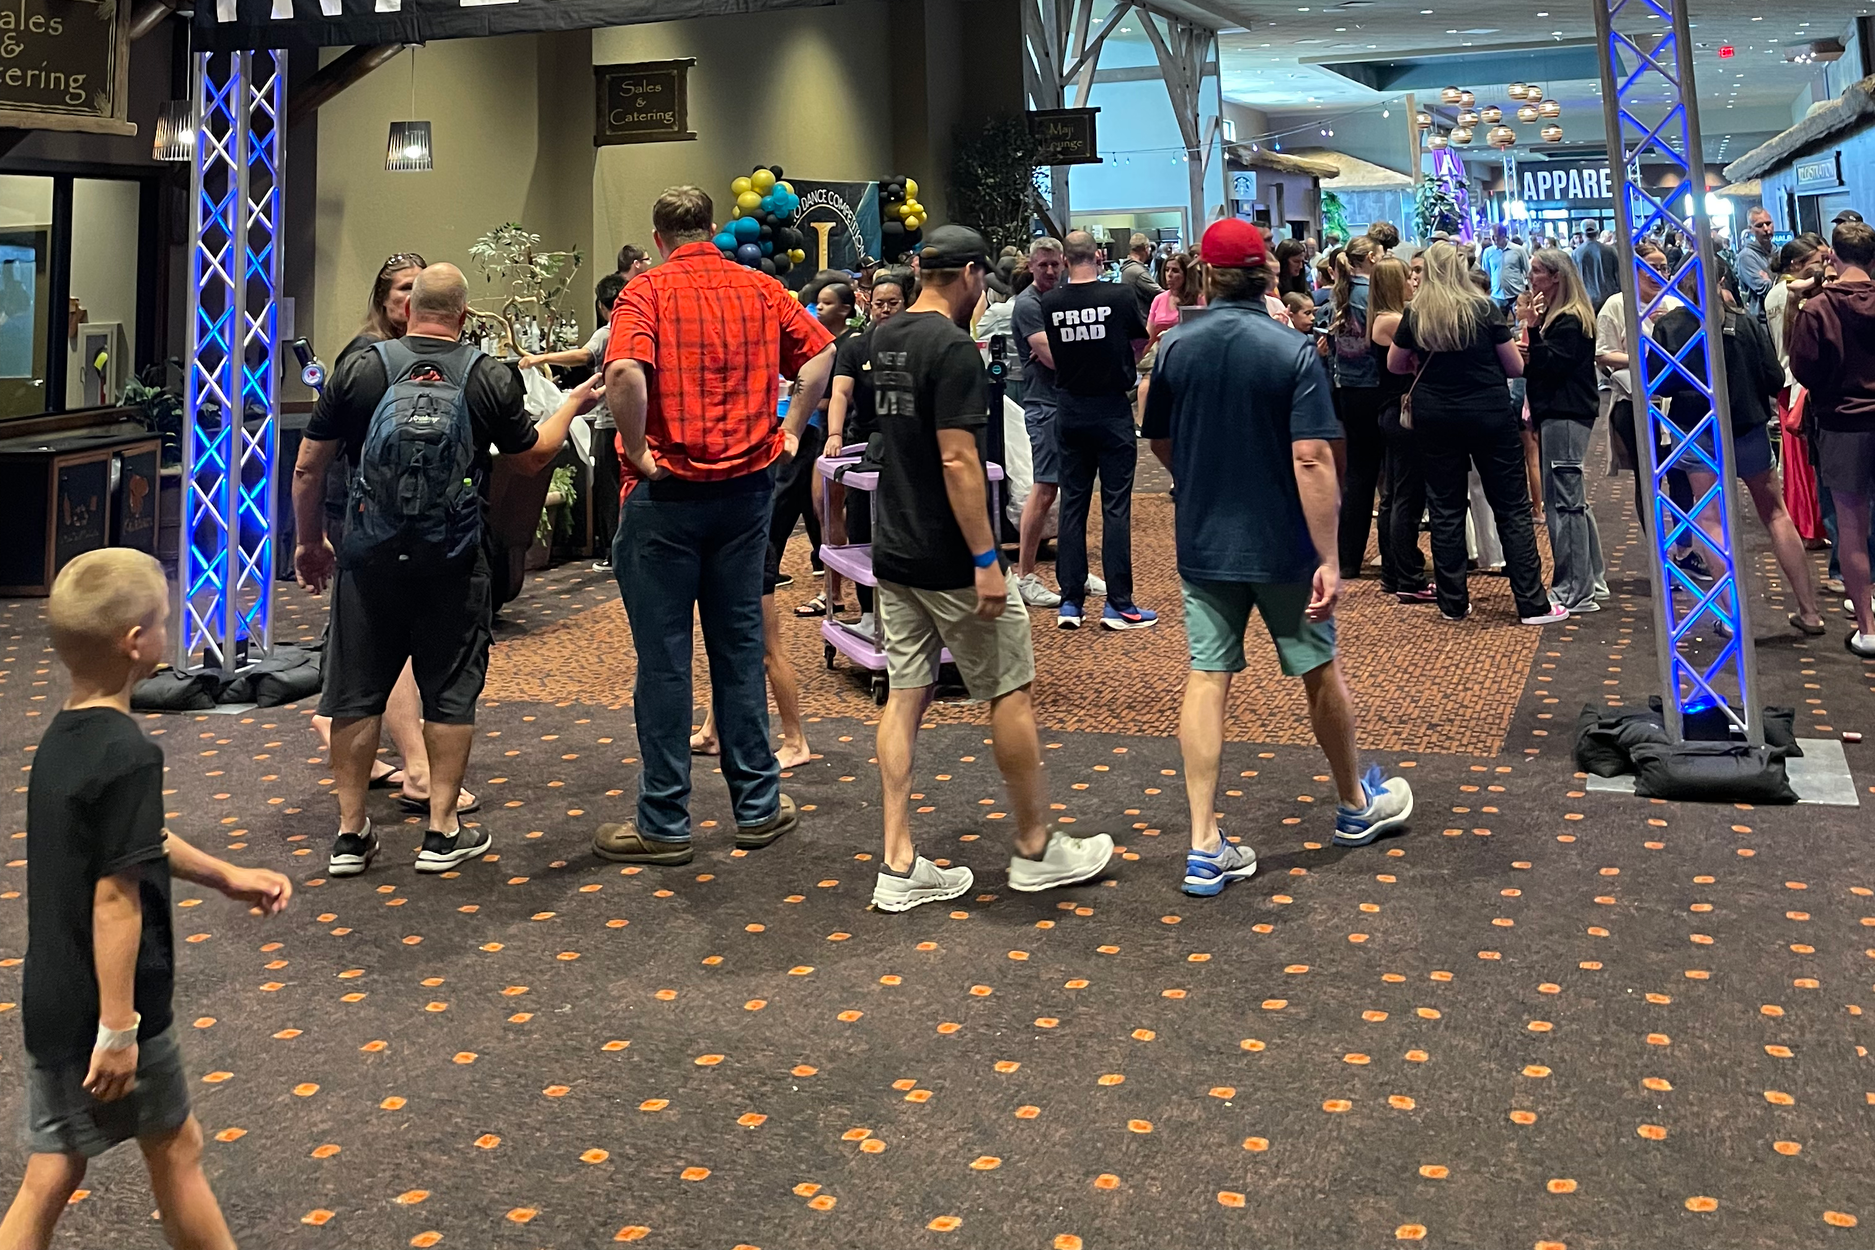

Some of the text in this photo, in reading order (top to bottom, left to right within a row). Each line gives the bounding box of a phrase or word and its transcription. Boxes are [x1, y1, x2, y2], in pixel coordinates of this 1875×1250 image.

[1, 32, 25, 58] &
[0, 60, 87, 105] ering
[619, 79, 662, 97] Sales
[635, 97, 647, 108] &
[610, 109, 674, 125] Catering
[1049, 122, 1074, 140] Maji
[1523, 167, 1613, 201] APPARE
[801, 189, 867, 259] DANCE COMPETITION
[1051, 306, 1112, 327] PROP
[1060, 324, 1106, 343] DAD
